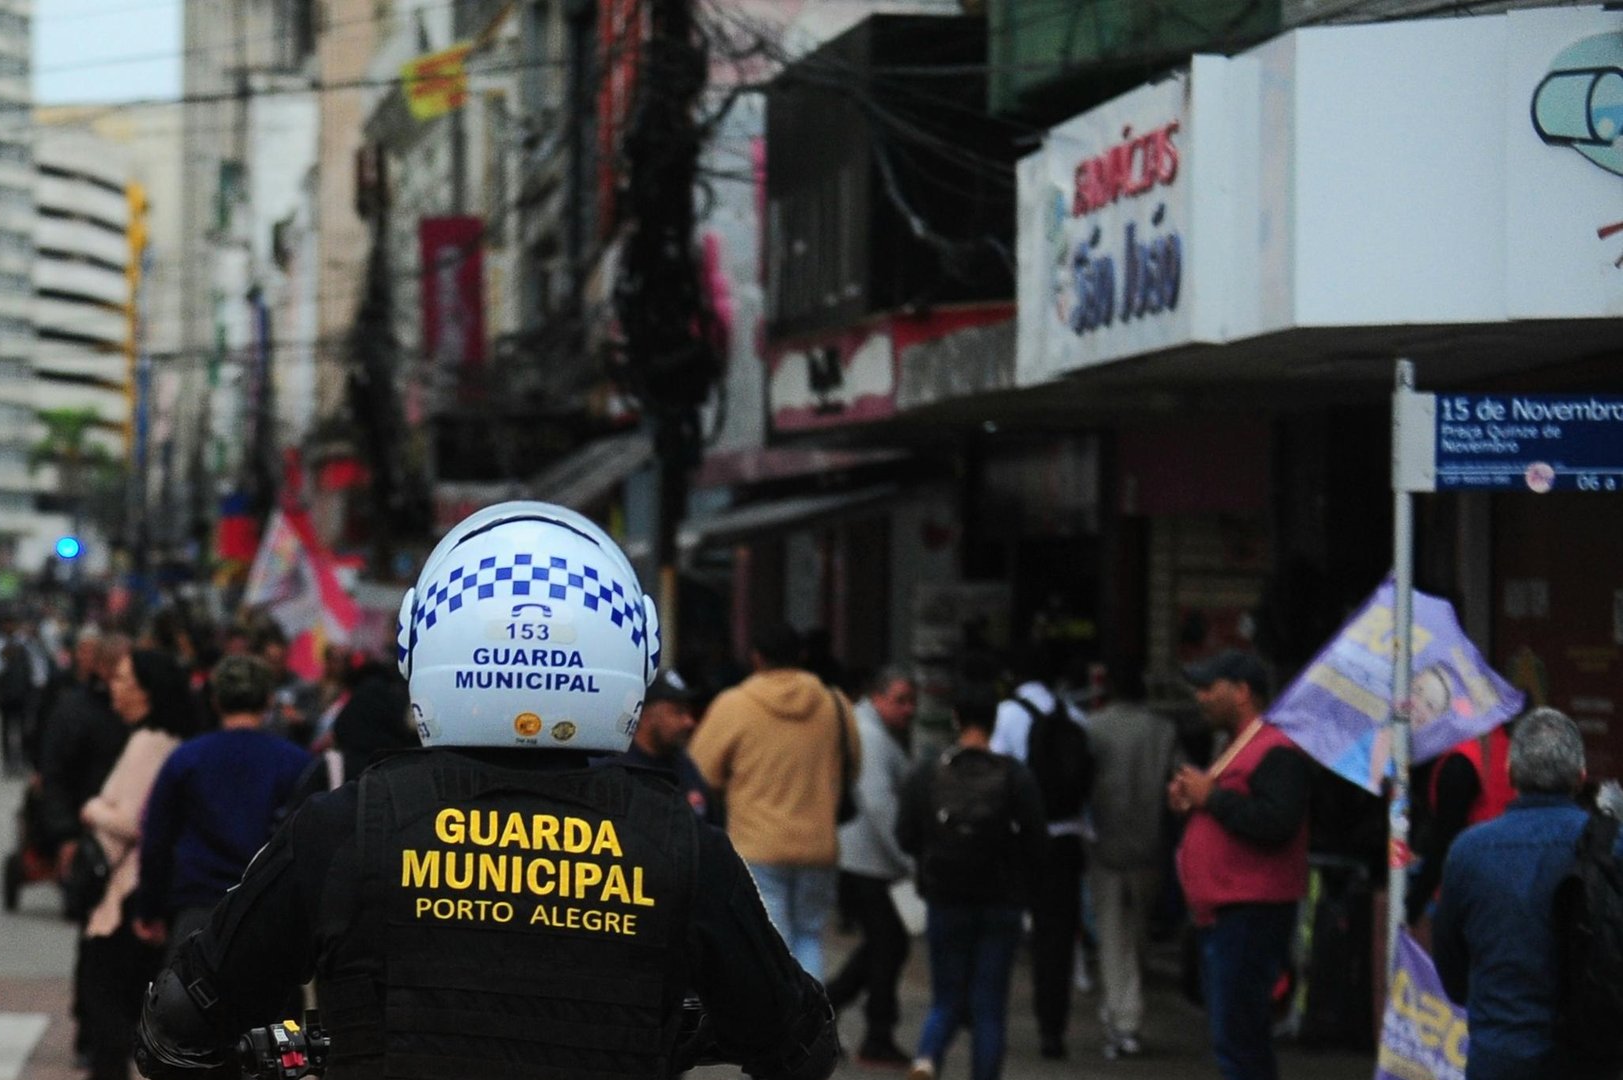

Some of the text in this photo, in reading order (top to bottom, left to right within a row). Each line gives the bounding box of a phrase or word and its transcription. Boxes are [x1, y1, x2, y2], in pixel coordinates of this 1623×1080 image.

[1441, 396, 1623, 421] 15 de Novembro
[1441, 424, 1563, 440] Praça Quinze de
[1441, 438, 1520, 453] Novembro
[506, 623, 550, 641] 153
[473, 648, 584, 668] GUARDA
[455, 671, 600, 693] MUNICIPAL
[435, 808, 623, 857] GUARDA
[401, 850, 655, 907] MUNICIPAL
[416, 898, 638, 935] PORTO ALEGRE
